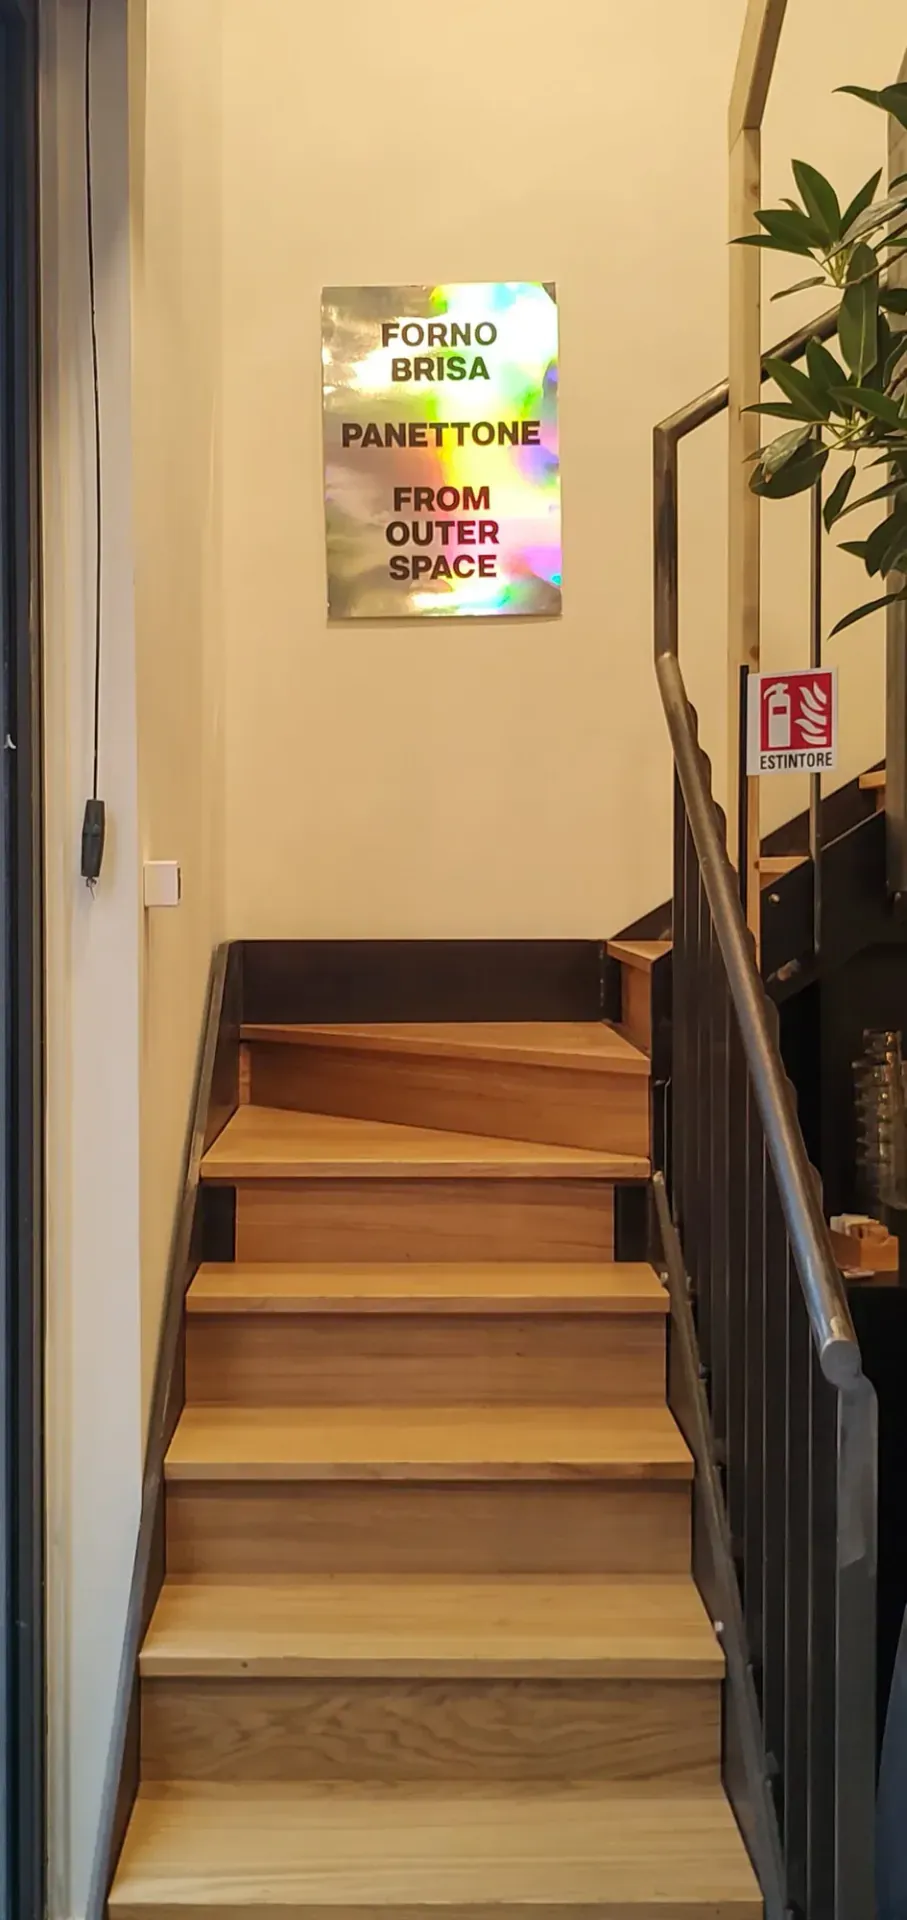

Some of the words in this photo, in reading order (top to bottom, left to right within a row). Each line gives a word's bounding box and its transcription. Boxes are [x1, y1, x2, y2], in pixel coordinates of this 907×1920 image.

[381, 321, 497, 347] FORNO
[391, 356, 490, 382] BRISA
[341, 420, 541, 448] PANETTONE
[393, 486, 490, 512] FROM
[385, 520, 499, 546] OUTER
[389, 554, 497, 581] SPACE
[760, 752, 832, 770] ESTINTORE
